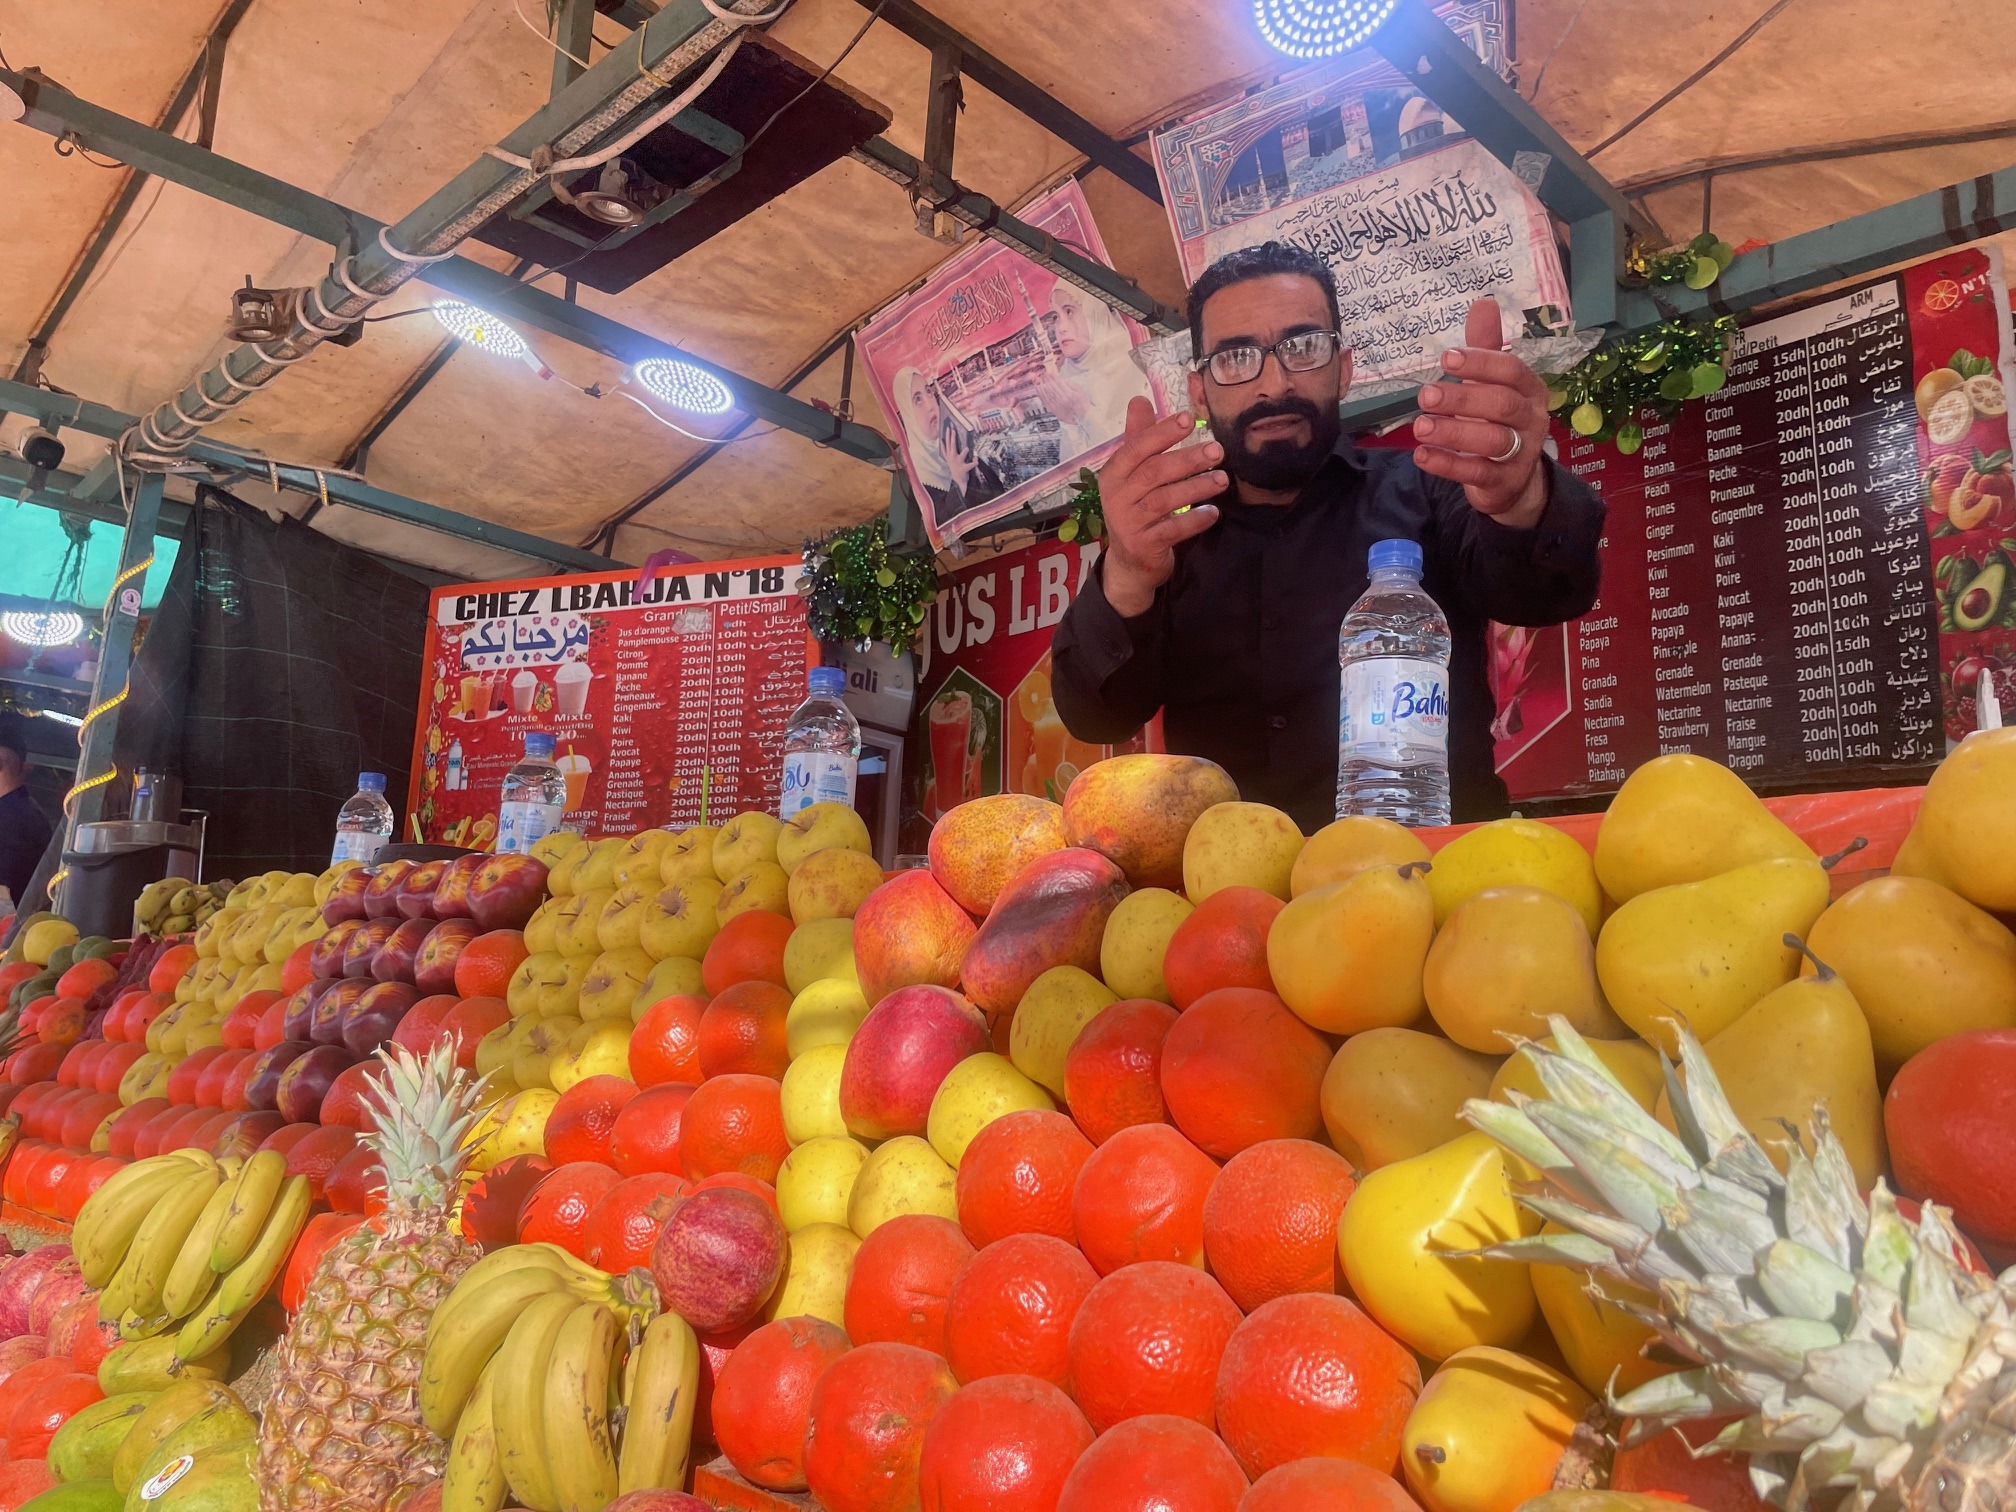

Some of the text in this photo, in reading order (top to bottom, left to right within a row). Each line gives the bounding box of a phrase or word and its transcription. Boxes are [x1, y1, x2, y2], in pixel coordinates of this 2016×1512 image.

[1850, 289, 1873, 310] ARM
[1846, 313, 1904, 346] البرتقال
[1773, 348, 1805, 367] 15dh
[1810, 337, 1844, 356] 10dh
[1704, 354, 1846, 404] Pamplemousse 20dh 10dh
[1860, 358, 1904, 383] حامض
[1872, 376, 1901, 403] تفاح
[1571, 372, 1847, 458] Limon Lemon Citron 20dh 10dh
[1881, 400, 1904, 418] موز
[1572, 395, 1849, 476] Manzana Apple Pomme 20dh 10dh
[1876, 418, 1908, 445] خوخ
[1644, 415, 1851, 478] Banana Banane 20dh 10dh
[1645, 437, 1852, 498] Peach Peche 20dh 10dh
[1646, 458, 1854, 519] Prunes Pruneaux 20dh 10dh
[1646, 483, 1857, 540] Ginger Gingembre 20dh 10dh
[1647, 506, 1860, 562] Persimmon Kaki 20dh 10dh
[1648, 526, 1862, 582] Kiwi Kiwi 20dh 10dh
[1649, 546, 1863, 600] Pear Poire 20dh 10dh
[455, 566, 784, 620] CHEZ LBAHJA N°18
[1580, 569, 1866, 636] Aguacate Avocado Avocat 20dh 10dh
[720, 598, 786, 616] Petit/Small
[619, 627, 634, 637] Jus
[918, 573, 996, 683] JUS
[1580, 592, 1868, 652] Papaya Papaya Papaye 20dh 10dh
[1898, 624, 1926, 643] رمان
[461, 618, 588, 671] مرحبا بكم
[617, 650, 643, 659] Citron
[618, 635, 679, 647] Pamplemousse
[1582, 656, 1600, 670] Pina
[1721, 632, 1756, 648] Ananas
[1794, 622, 1828, 639] 20dh
[617, 661, 648, 670] Pomme
[1582, 636, 1870, 690] Granada Grenade Grenade 30dh 15dh
[616, 672, 648, 682] Banane
[616, 683, 641, 692] Peche
[1584, 658, 1874, 711] Sandia Watermelon Pasteque 20dh 10dh
[614, 692, 655, 702] Pruneaux
[614, 702, 661, 713] Gingembre
[1584, 680, 1875, 730] Nectarina Nectarine Nectarine 20dh 10dh
[508, 715, 538, 724] Mixte
[554, 712, 592, 722] Mixte
[612, 726, 631, 735] Kiwi
[614, 714, 632, 722] Kaki
[1586, 700, 1877, 747] Fresa Strawberry Fraise 20dh 10dh
[610, 748, 640, 757] Avocat
[612, 738, 634, 747] Poire
[1588, 751, 1616, 766] Mango
[1728, 734, 1766, 752] Mangue
[1802, 726, 1837, 742] 20dh
[1844, 721, 1879, 738] 10dh
[608, 770, 640, 779] Ananas
[610, 758, 641, 768] Papaye
[1589, 742, 1880, 782] Pitahaya Dragon 30dh 15dh
[607, 779, 643, 788] Grenade
[604, 812, 630, 821] Fraise
[605, 800, 647, 809] Nectarine
[602, 823, 636, 833] Mangue
